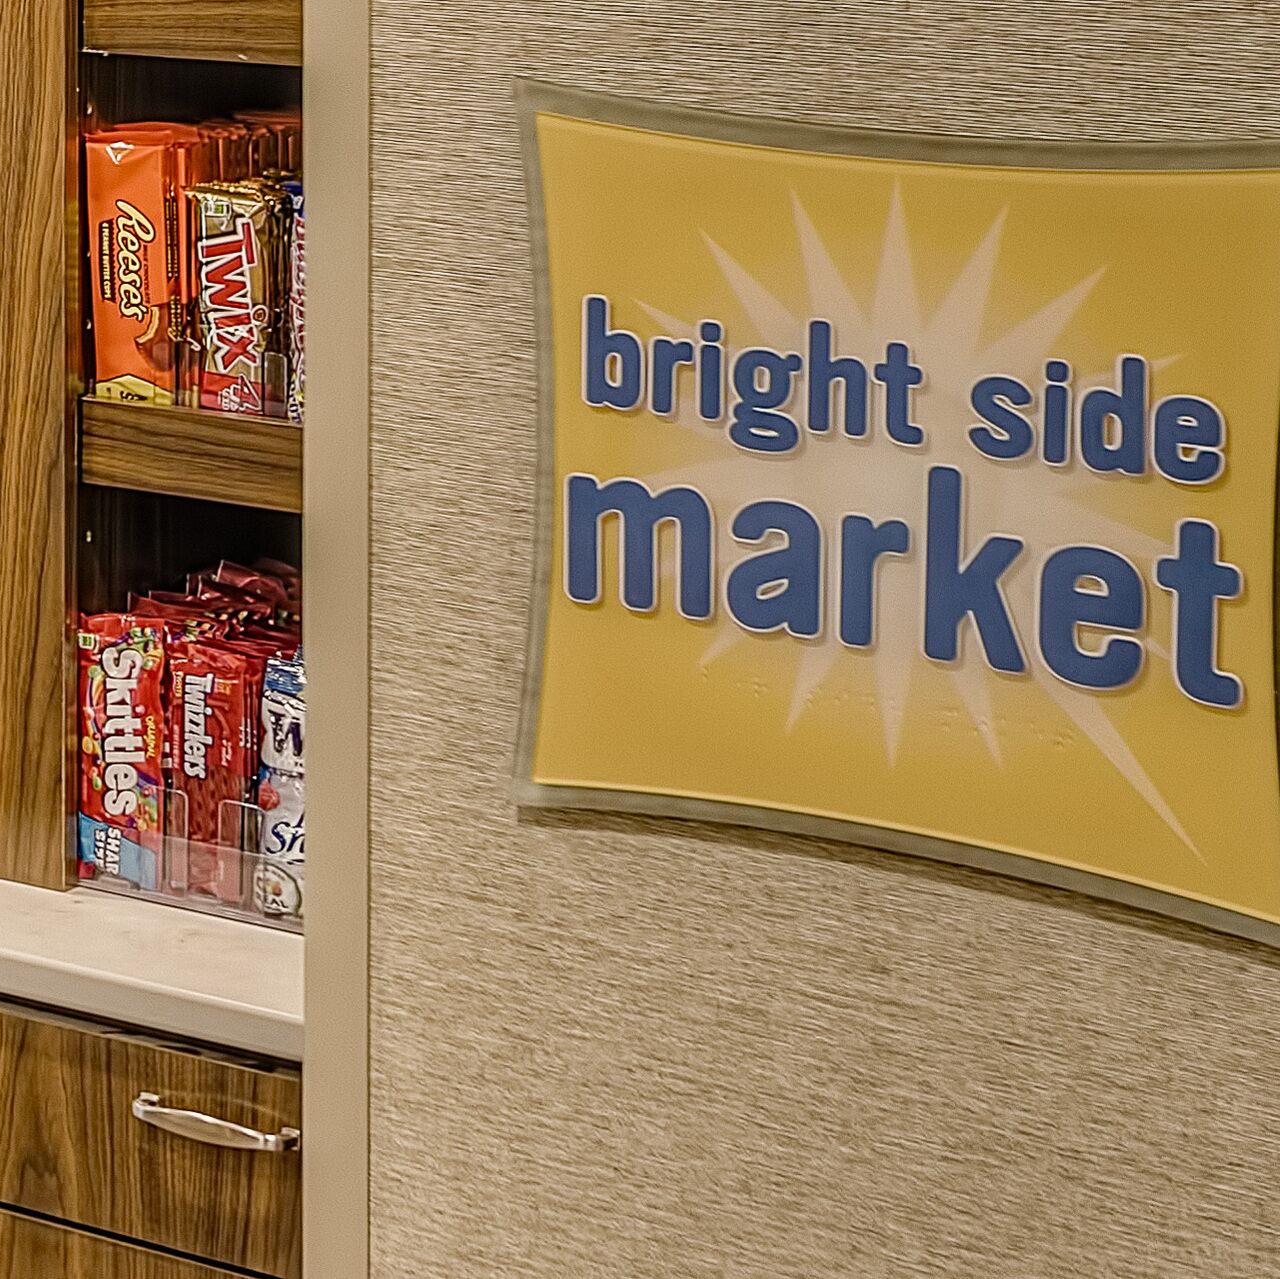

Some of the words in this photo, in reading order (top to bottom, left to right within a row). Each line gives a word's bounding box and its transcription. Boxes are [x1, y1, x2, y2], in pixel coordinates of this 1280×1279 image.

[116, 199, 155, 321] Reese's
[579, 294, 927, 454] bright
[966, 353, 1226, 486] side
[563, 464, 1245, 710] market
[102, 646, 146, 817] Skittles
[184, 673, 215, 781] Twizzlers
